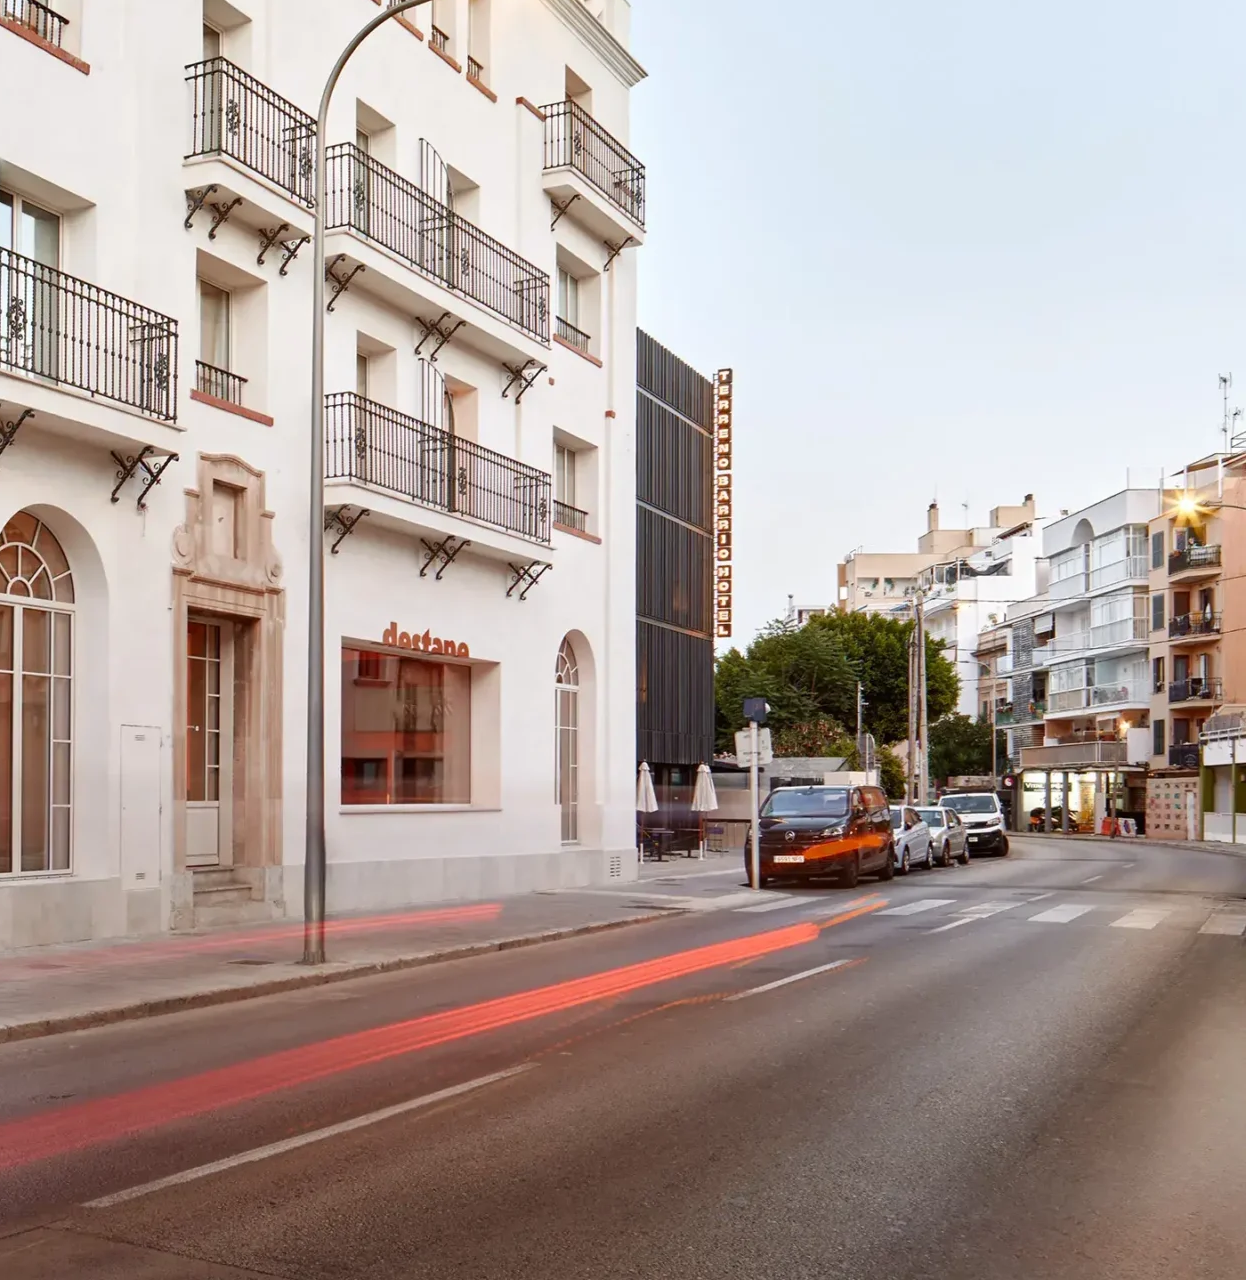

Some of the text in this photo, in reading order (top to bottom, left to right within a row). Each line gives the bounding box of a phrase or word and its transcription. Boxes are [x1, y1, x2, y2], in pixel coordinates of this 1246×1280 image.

[717, 370, 731, 636] TERRENO BARRIO HOTEL
[382, 621, 469, 658] dostano
